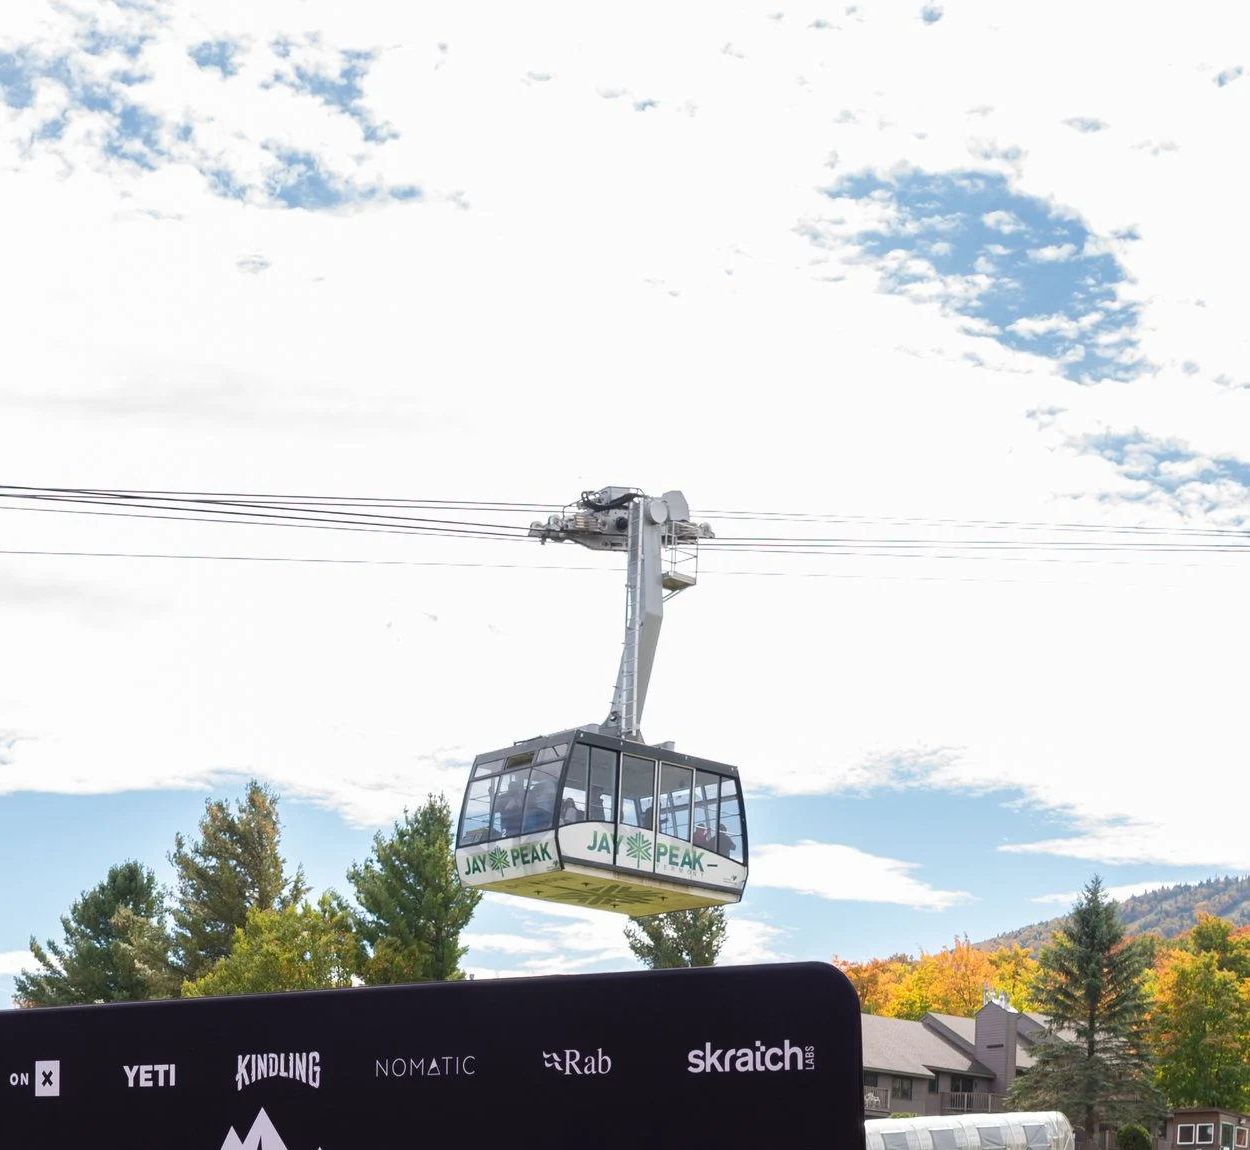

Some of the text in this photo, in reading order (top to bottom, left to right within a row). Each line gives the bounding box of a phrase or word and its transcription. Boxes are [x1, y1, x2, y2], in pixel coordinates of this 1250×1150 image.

[501, 828, 507, 838] 2
[465, 842, 552, 876] JAY PEAK
[587, 831, 705, 873] JAY PEAK
[375, 1055, 476, 1078] NOMATIC
[563, 1048, 612, 1076] Rab
[687, 1040, 803, 1073] skratch
[805, 1045, 815, 1070] LABS
[9, 1071, 54, 1087] ON X
[123, 1063, 176, 1088] YETI
[236, 1051, 321, 1091] KINDLING
